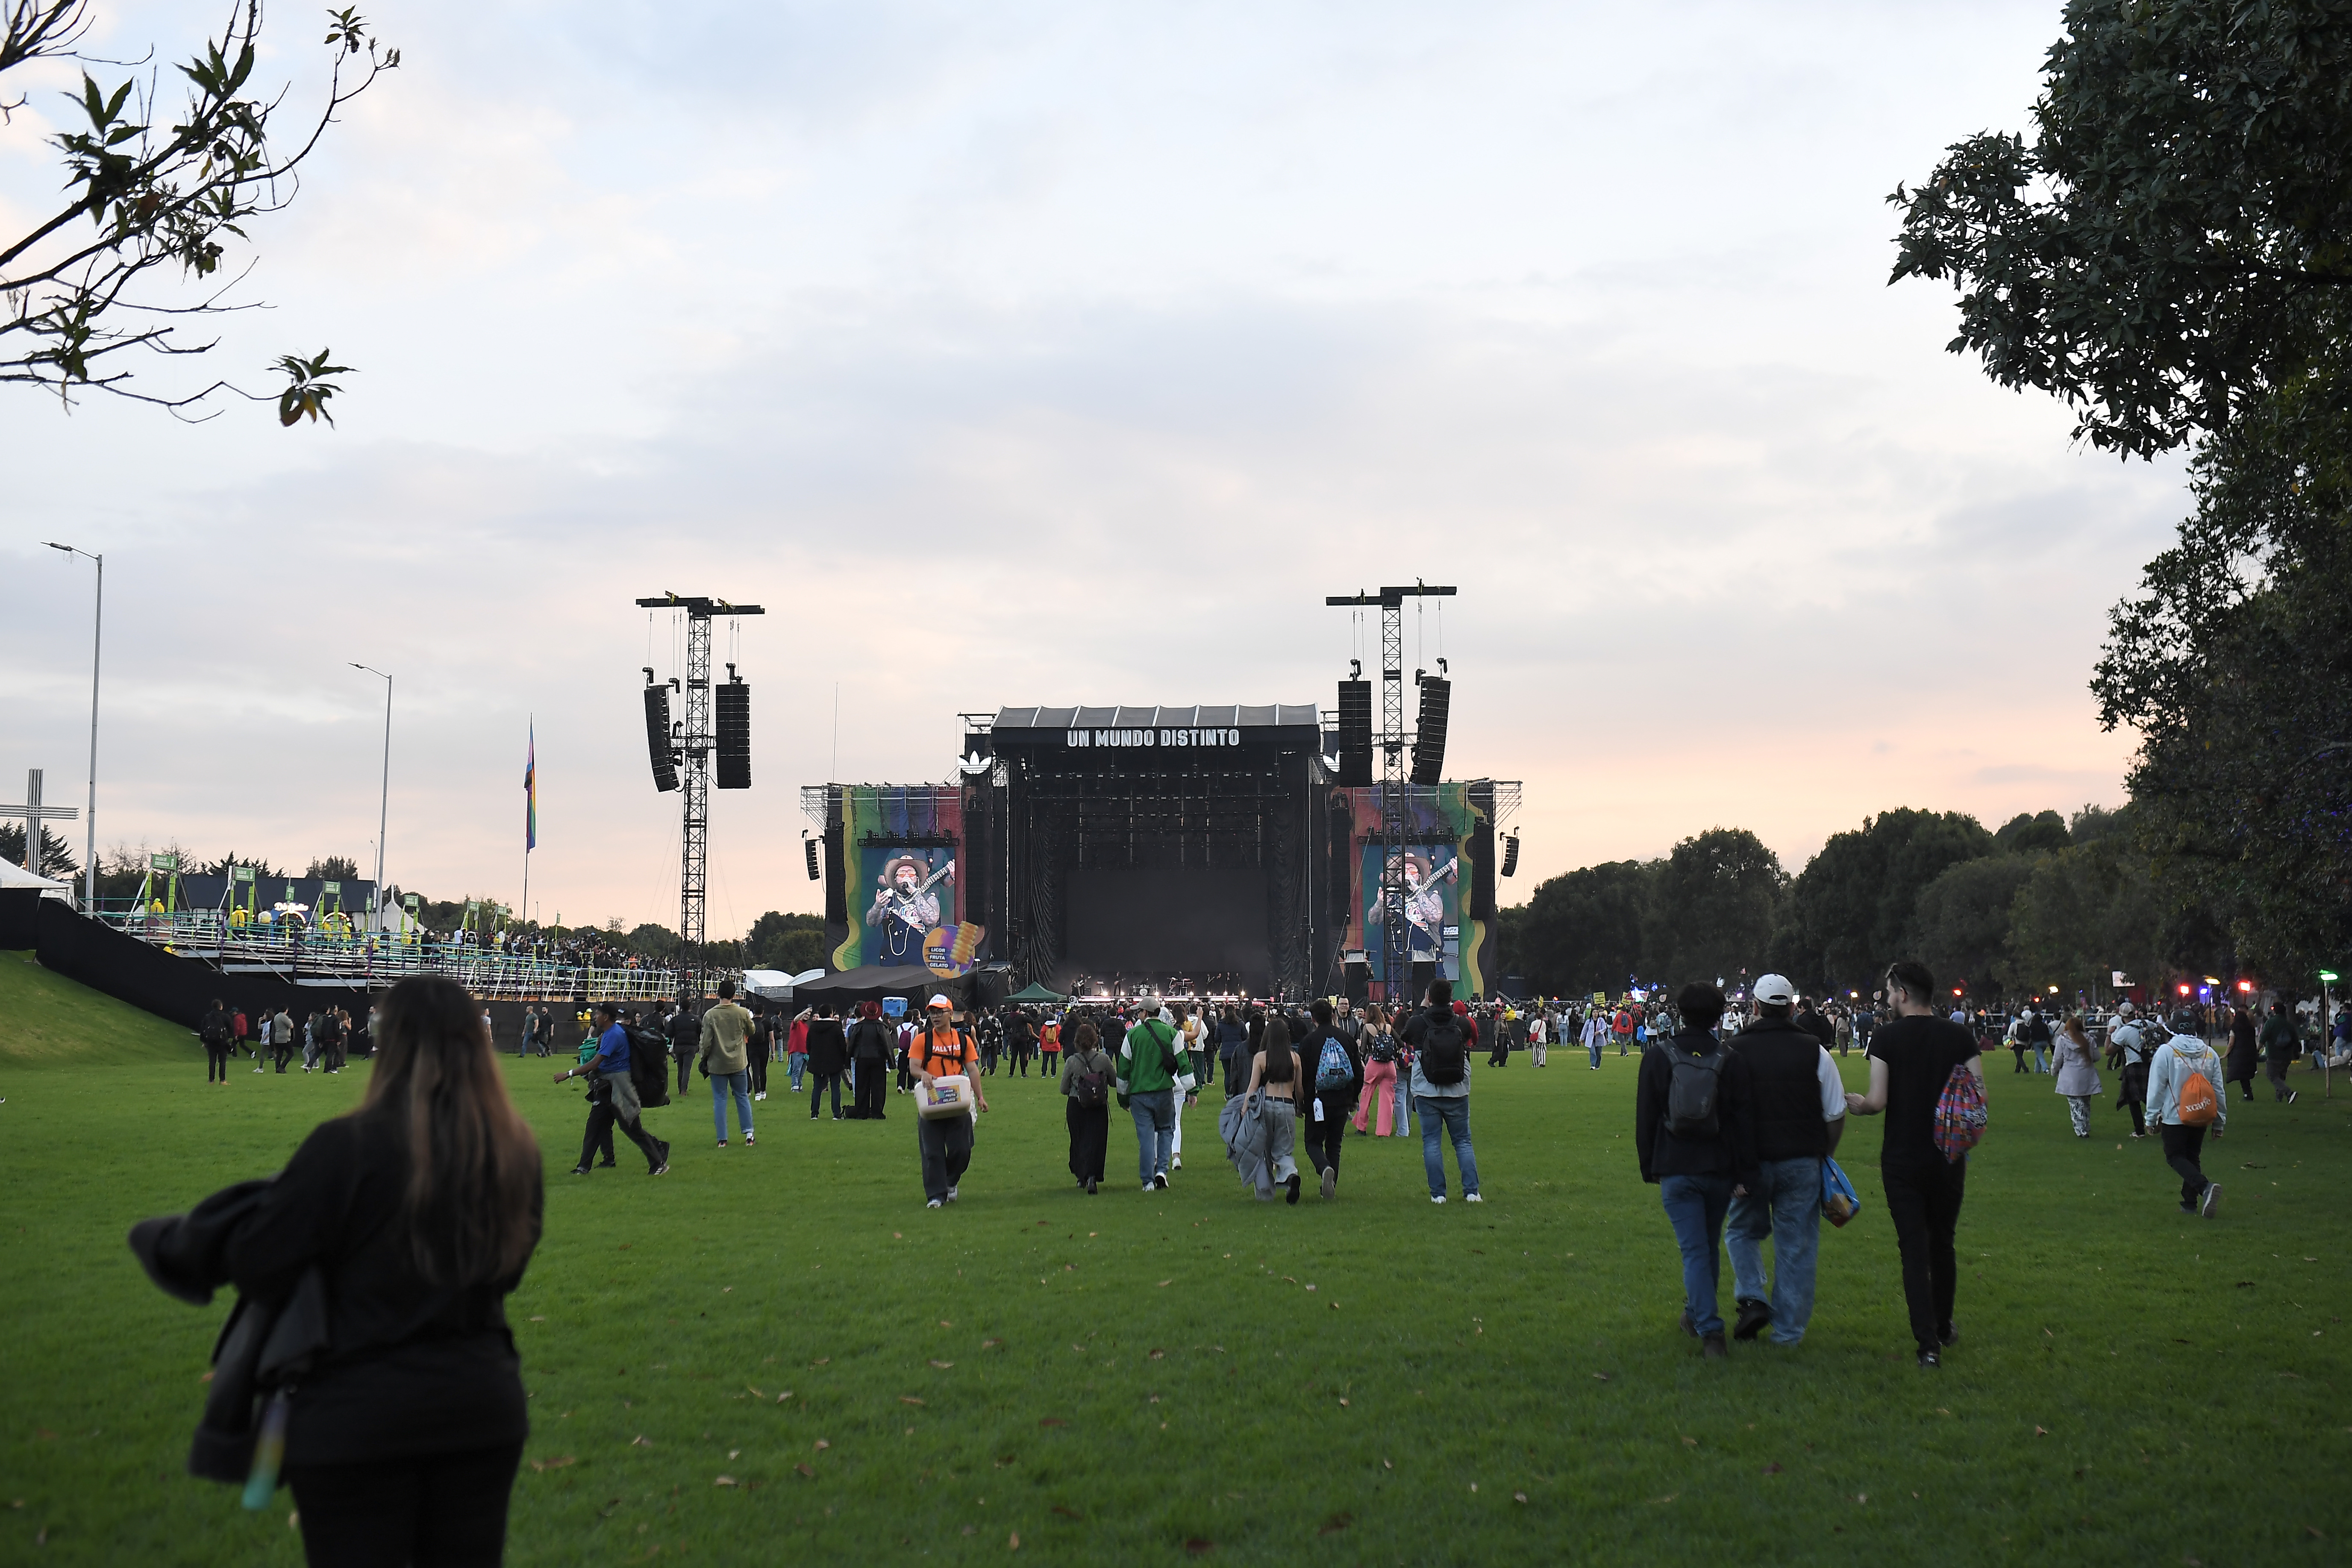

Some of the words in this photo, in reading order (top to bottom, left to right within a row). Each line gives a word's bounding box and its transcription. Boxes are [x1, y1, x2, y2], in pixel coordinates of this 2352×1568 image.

[1067, 730, 1090, 747] UN
[1095, 729, 1155, 747] MUNDO
[1160, 729, 1240, 746] DISTINTO
